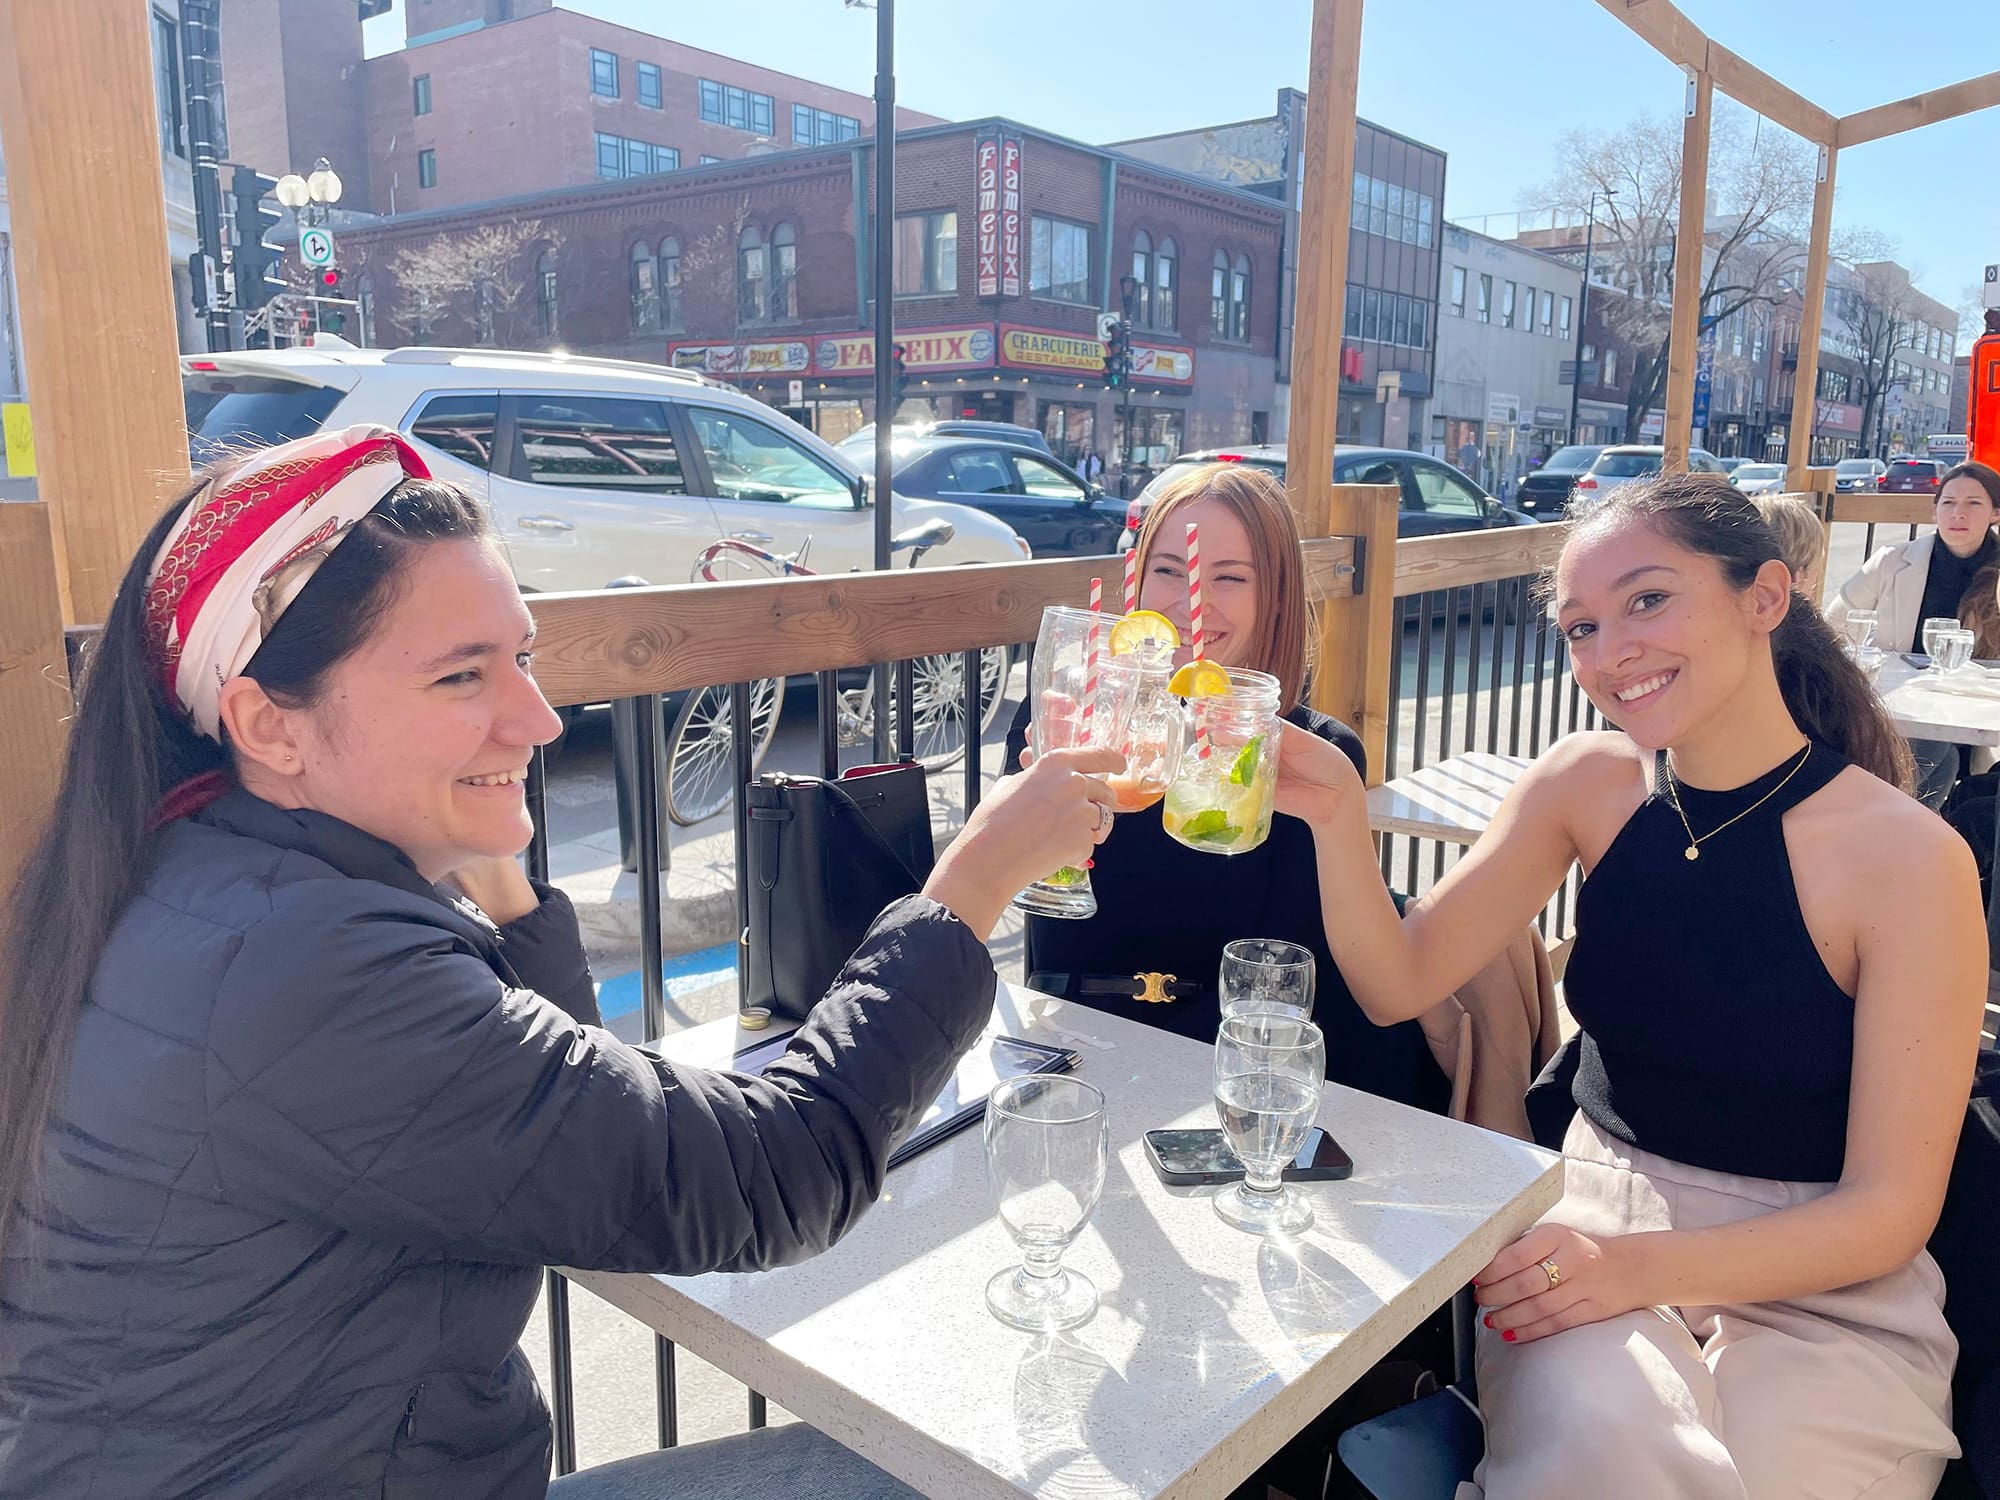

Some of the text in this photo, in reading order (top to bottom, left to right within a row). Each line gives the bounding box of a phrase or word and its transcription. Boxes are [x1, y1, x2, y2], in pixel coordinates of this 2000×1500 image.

[840, 336, 968, 366] FAEUX
[1012, 334, 1100, 357] CHARCUTERIE
[749, 350, 781, 364] PIZZA
[1016, 351, 1100, 367] RESTAURANT
